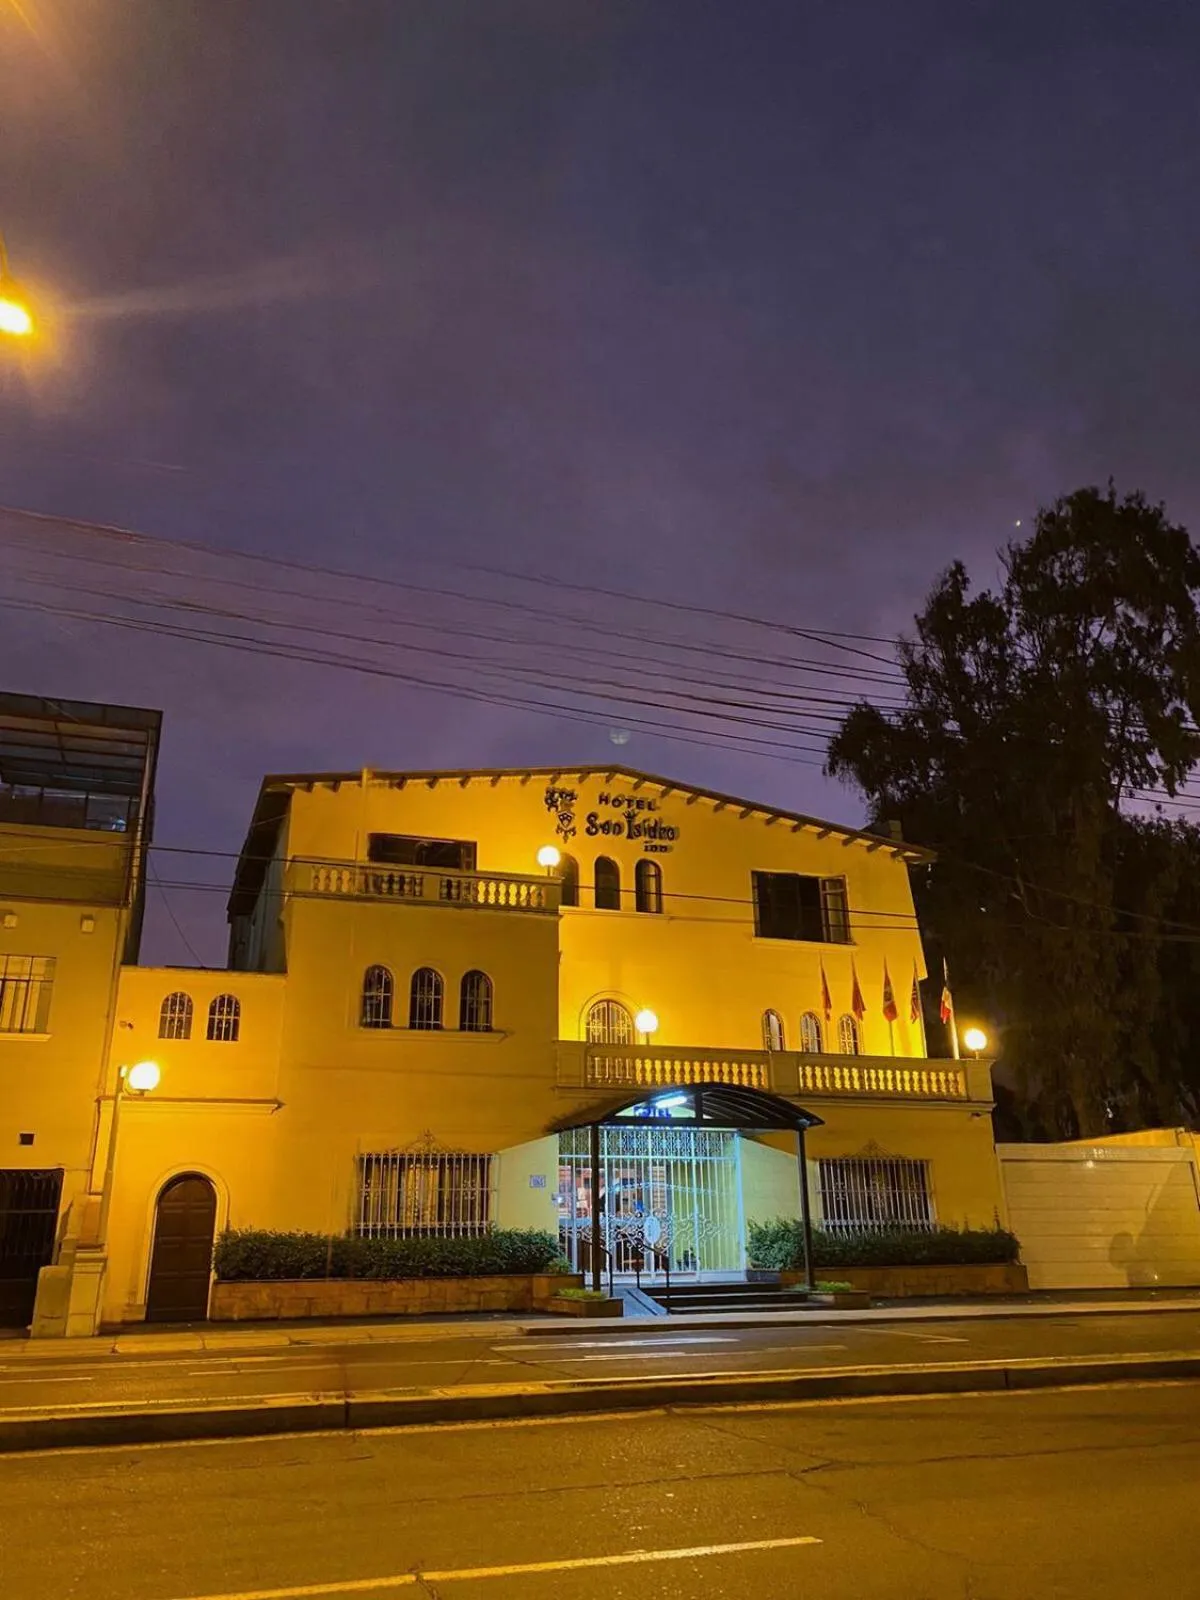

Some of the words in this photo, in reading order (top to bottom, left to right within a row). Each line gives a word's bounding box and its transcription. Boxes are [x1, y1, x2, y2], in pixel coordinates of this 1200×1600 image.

[598, 792, 659, 811] HOTEL
[585, 812, 623, 836] San
[622, 809, 678, 840] Isidro
